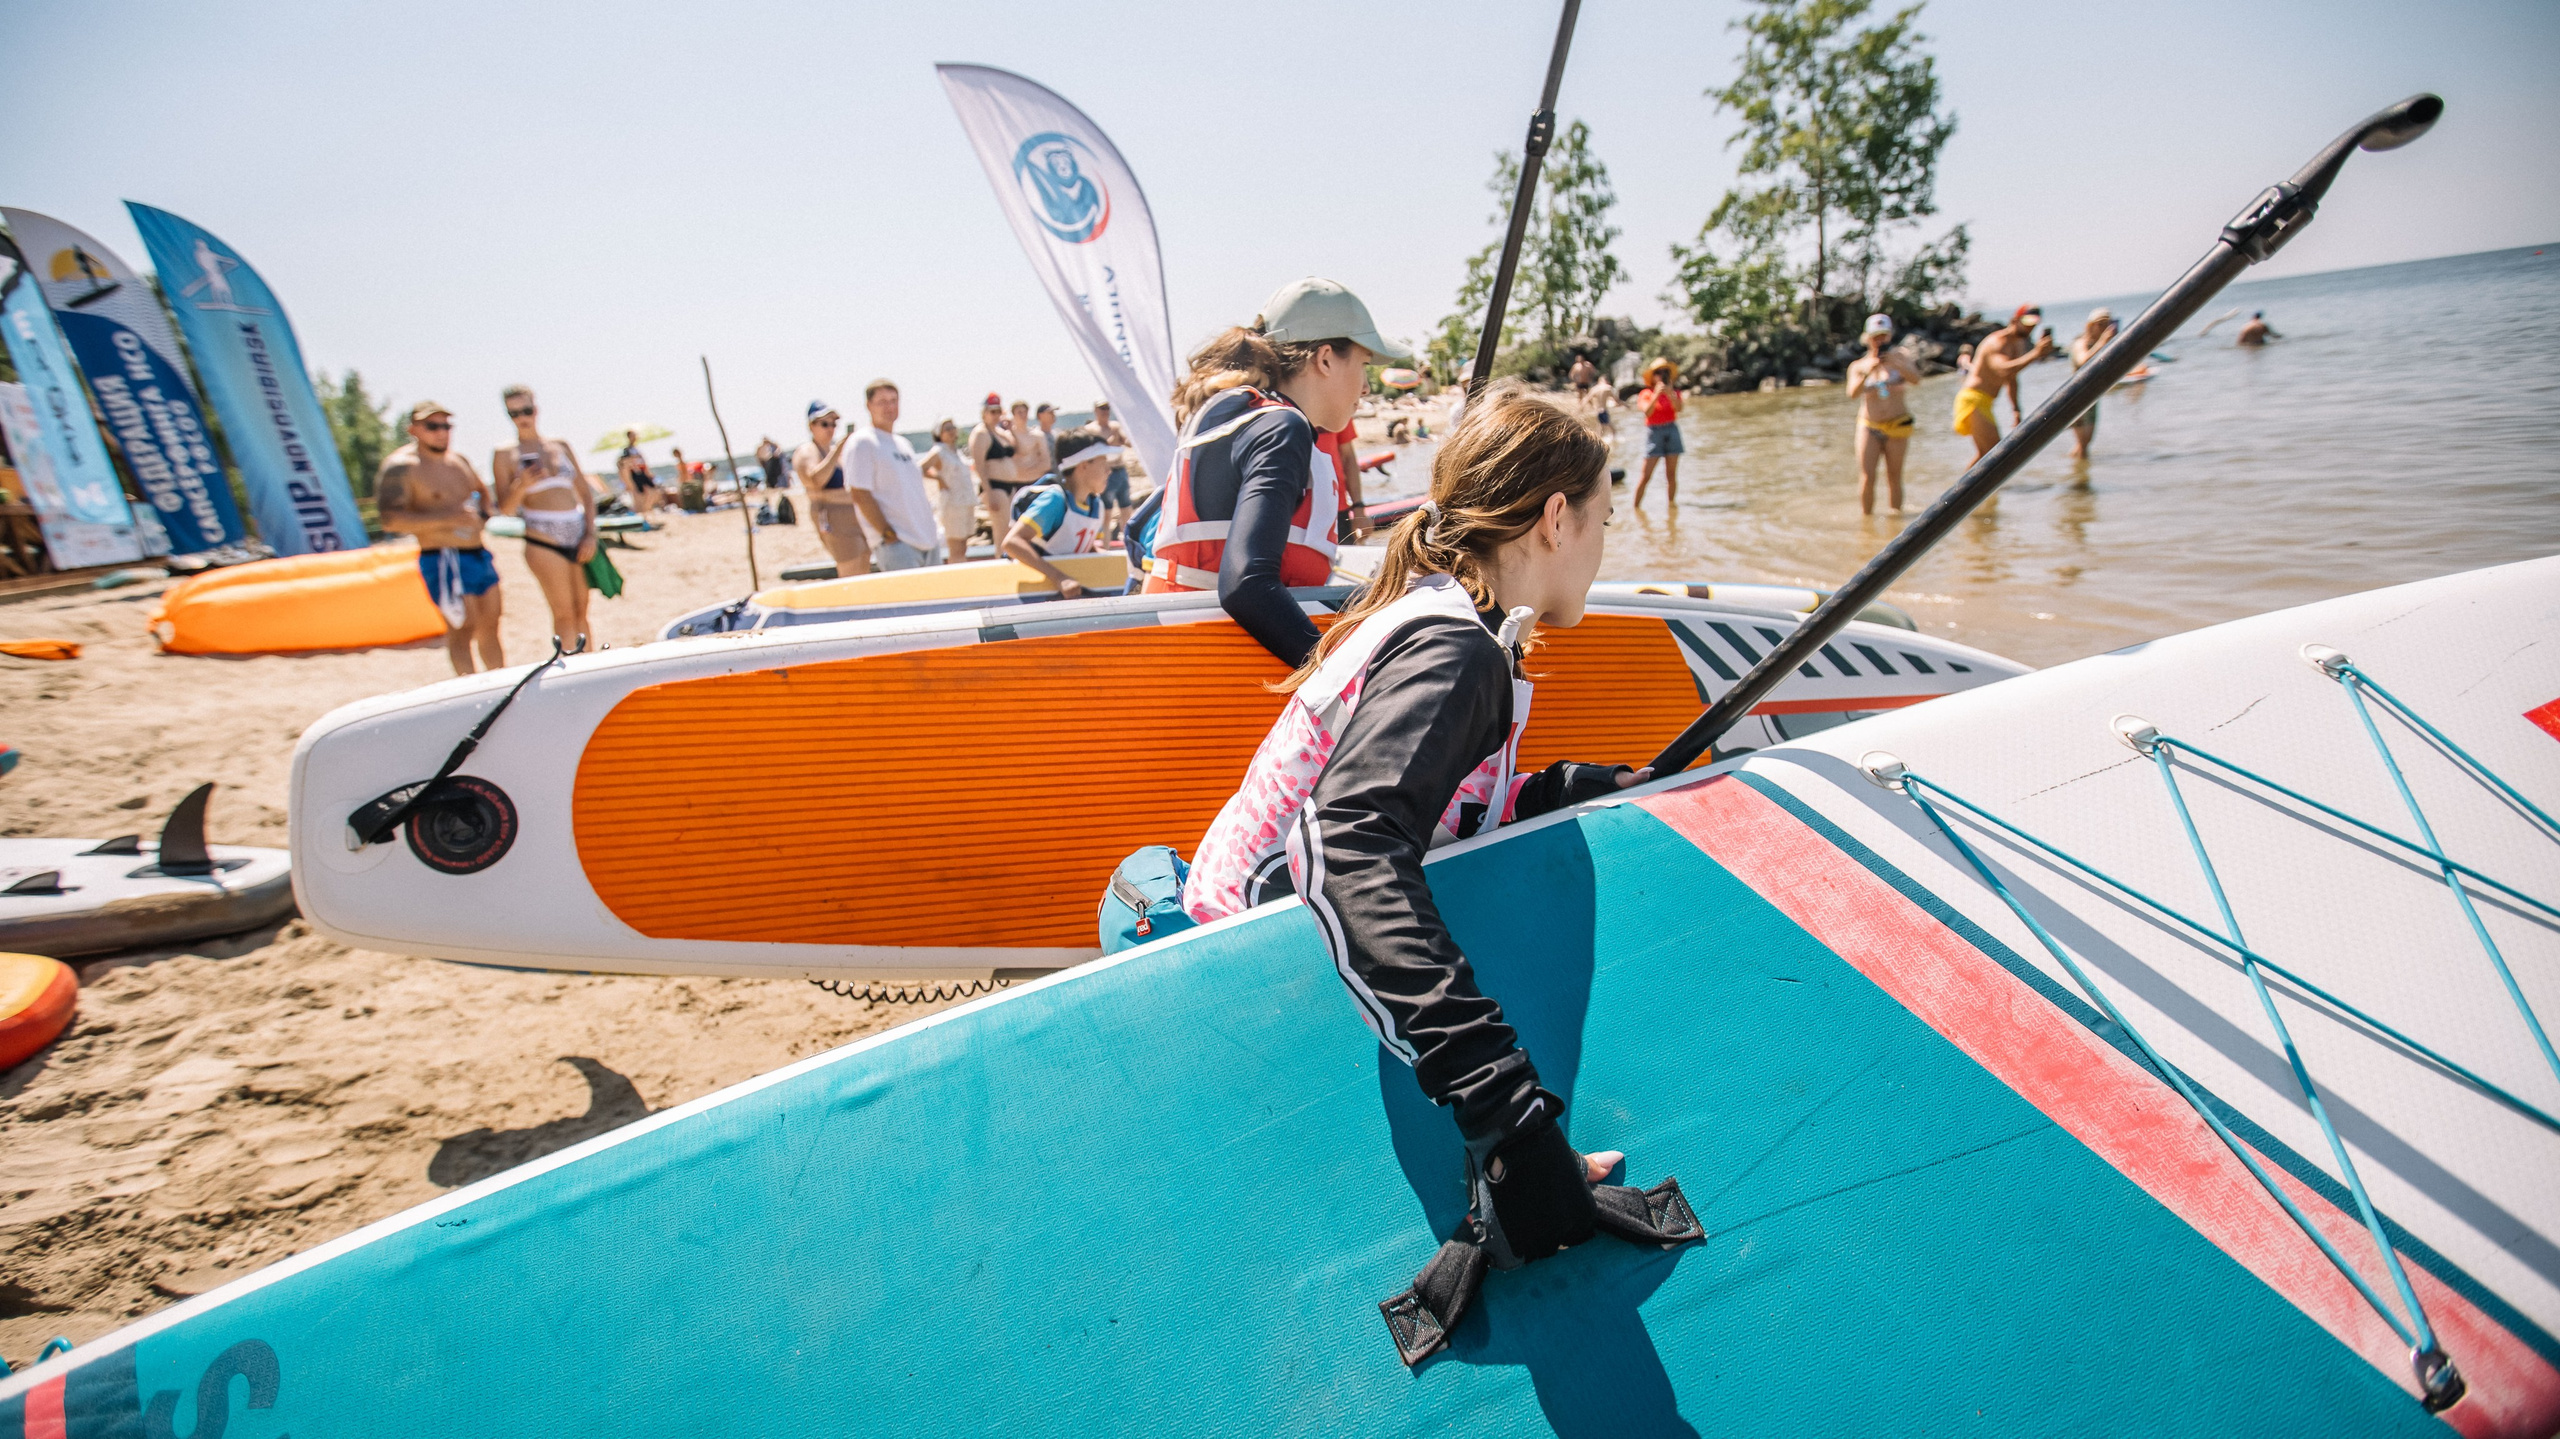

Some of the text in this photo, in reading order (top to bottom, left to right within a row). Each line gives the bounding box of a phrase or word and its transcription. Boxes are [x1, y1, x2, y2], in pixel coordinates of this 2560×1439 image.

[92, 374, 184, 514] ФЕДЕРАЦИЯ
[111, 330, 226, 544] САПСЕРФИНГА НСО
[238, 320, 343, 553] SUP NOVOSIBIRSK
[1137, 918, 1149, 933] red
